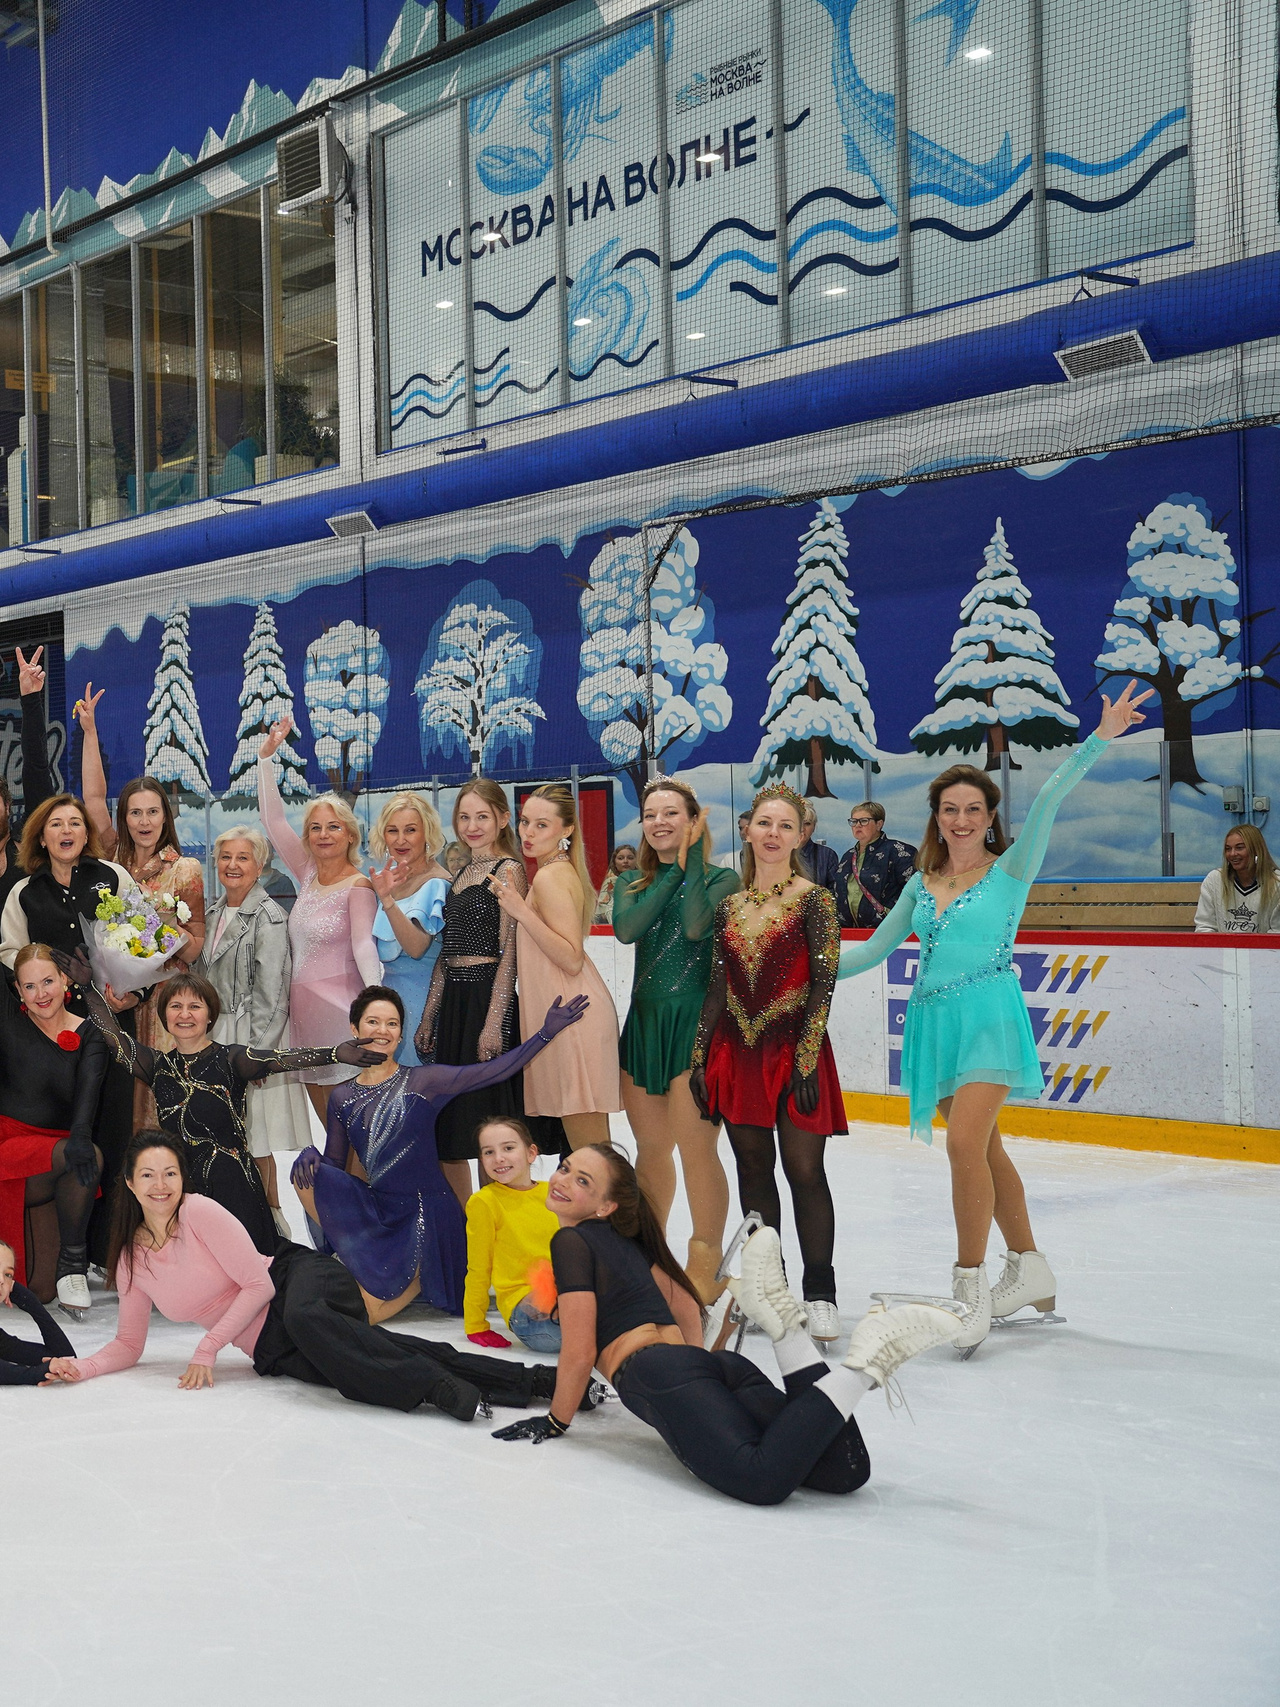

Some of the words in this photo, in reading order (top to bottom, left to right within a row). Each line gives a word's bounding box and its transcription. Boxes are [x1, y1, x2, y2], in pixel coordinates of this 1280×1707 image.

[710, 57, 737, 74] РЫБНЫЕ
[739, 48, 762, 63] РЫНКИ
[710, 62, 753, 88] МОСКВА
[710, 86, 725, 101] НА
[727, 70, 762, 95] ВОЛНЕ
[421, 195, 556, 277] МОСКВА
[568, 174, 617, 227] НА
[624, 115, 757, 207] ВОЛНЕ
